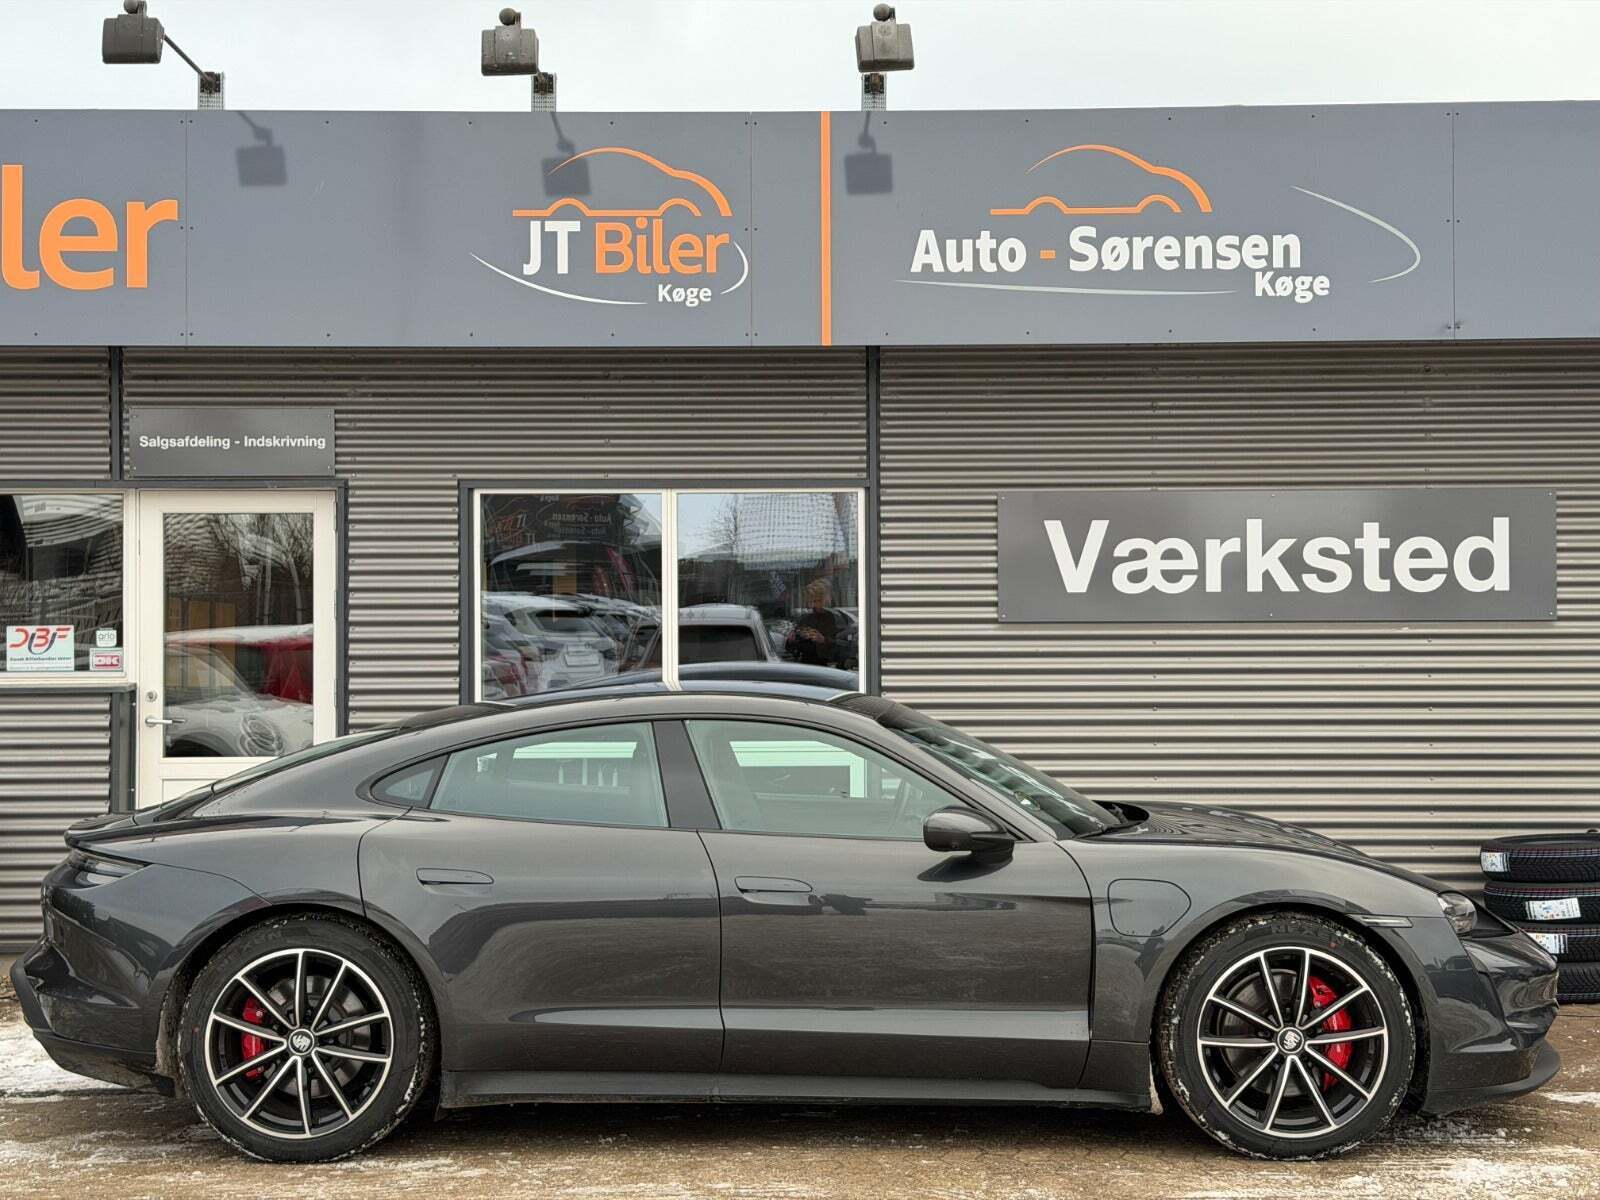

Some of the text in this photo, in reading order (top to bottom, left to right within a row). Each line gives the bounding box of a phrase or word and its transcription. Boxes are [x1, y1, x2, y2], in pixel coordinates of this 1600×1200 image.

[523, 217, 730, 276] JT Biler
[911, 229, 1027, 273] Auto
[1068, 225, 1302, 272] Sørensen
[657, 283, 712, 308] Køge
[1254, 270, 1331, 304] Køge
[139, 435, 231, 450] Salgsafdeling
[244, 434, 327, 450] Indskrivning
[1044, 516, 1510, 595] Værksted
